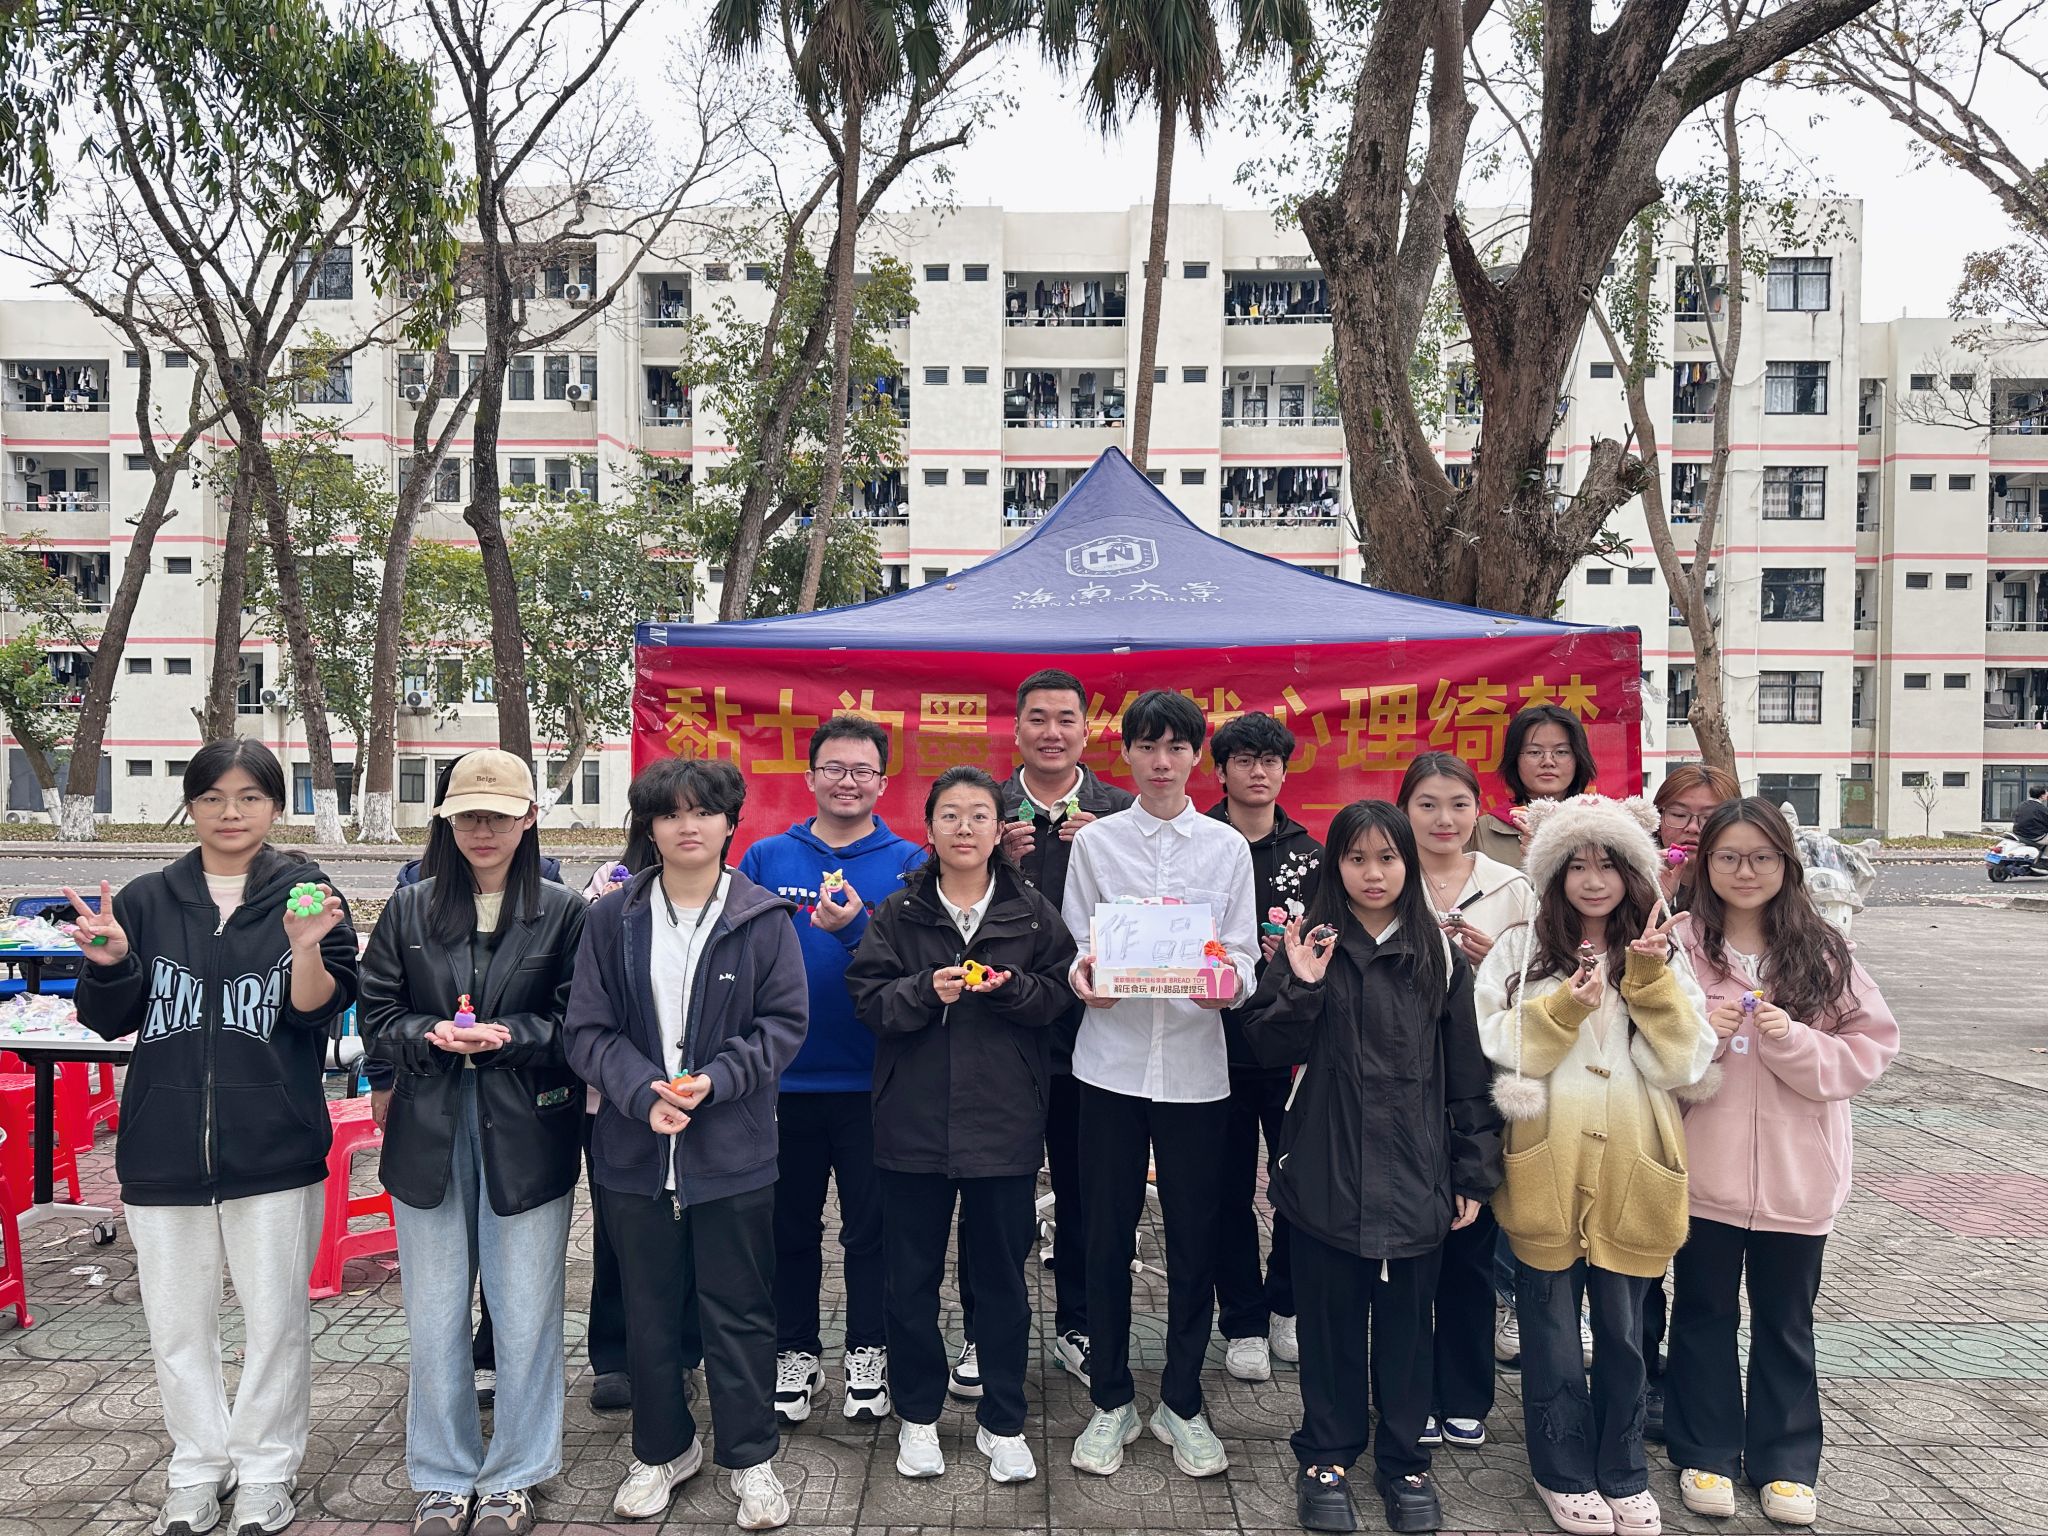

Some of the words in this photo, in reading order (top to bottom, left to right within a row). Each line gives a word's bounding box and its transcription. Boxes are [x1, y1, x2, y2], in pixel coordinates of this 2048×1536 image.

[1012, 579, 1220, 605] 海南大学
[1011, 600, 1091, 610] HAINAN
[476, 775, 497, 783] Beige
[1100, 913, 1203, 961] 作品
[1114, 984, 1148, 994] 解压食玩
